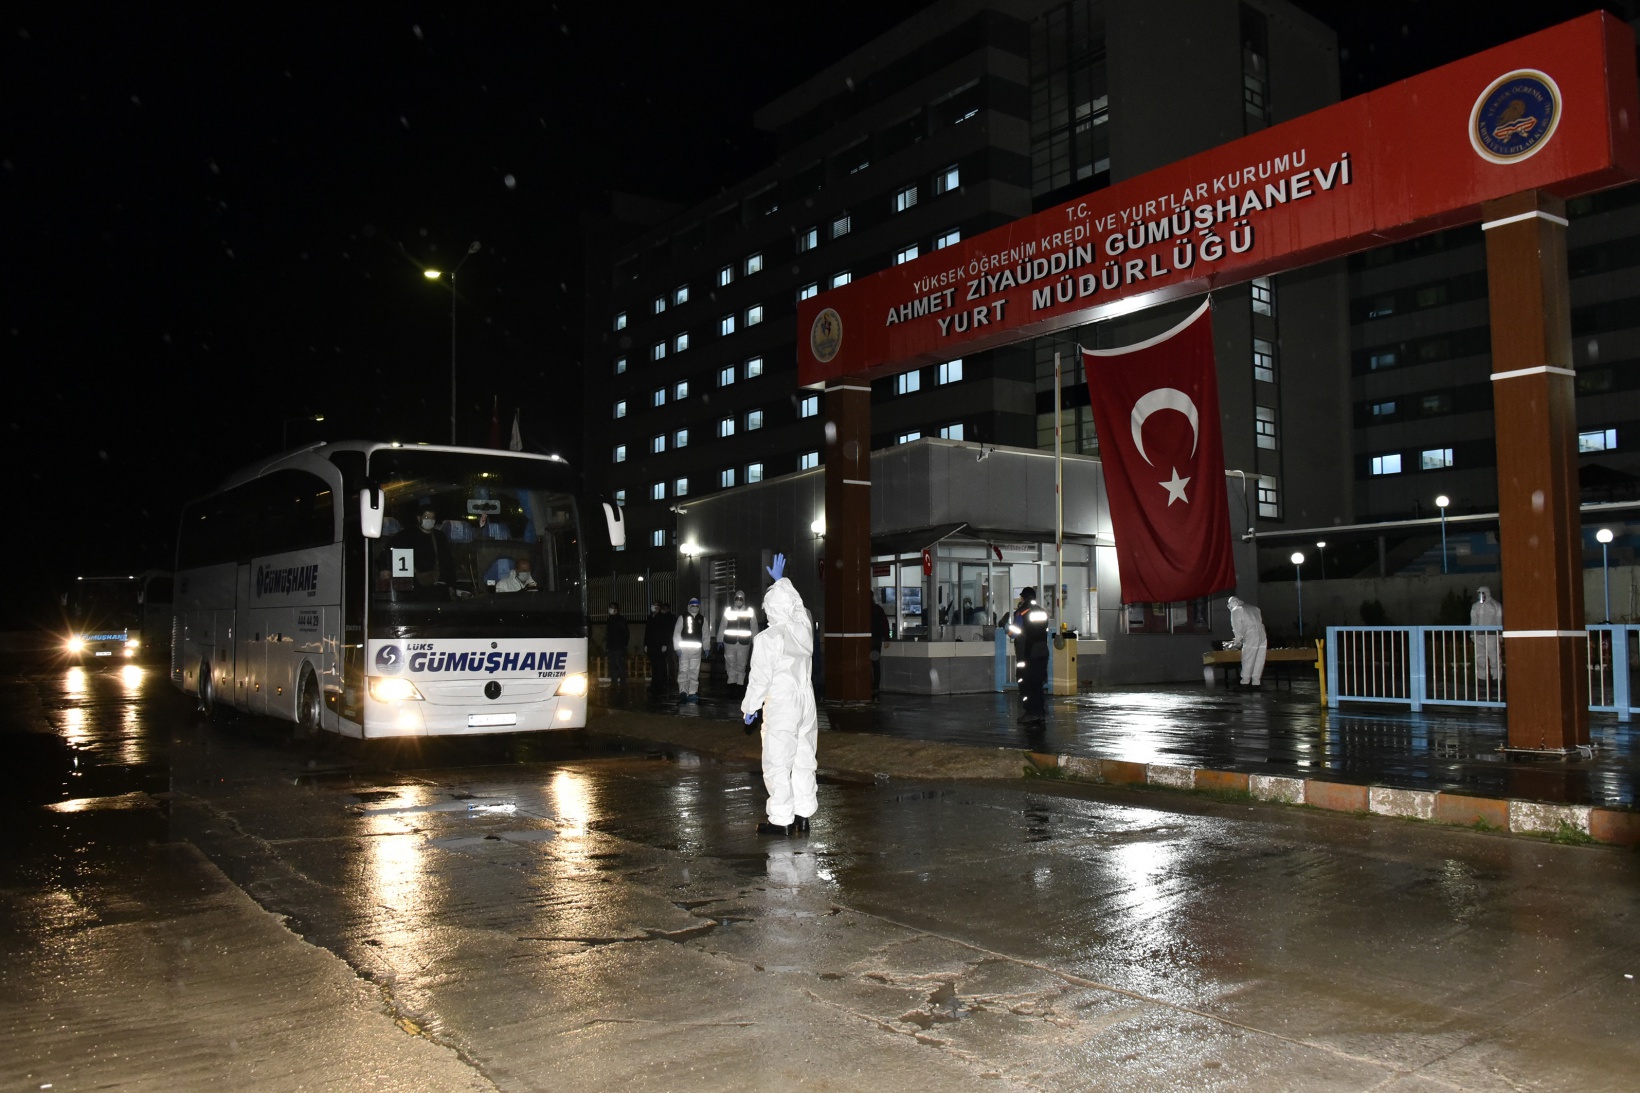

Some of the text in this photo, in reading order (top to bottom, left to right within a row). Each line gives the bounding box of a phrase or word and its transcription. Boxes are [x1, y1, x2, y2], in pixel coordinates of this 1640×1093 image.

[913, 148, 1306, 294] YÜKSEK ÖĞRENİM KREDİ VE YURTLAR KURUMU
[1066, 203, 1092, 222] T.C.
[886, 152, 1349, 326] AHMET ZİYAÜDDİN GÜMÜŞHANEVİ
[937, 219, 1252, 337] YURT MÜDÜRLÜĞÜ
[398, 556, 409, 572] 1
[263, 564, 319, 596] GÜMÜŞHANE
[406, 643, 434, 651] LÜKS
[408, 651, 568, 674] GÜMÜŞHANE
